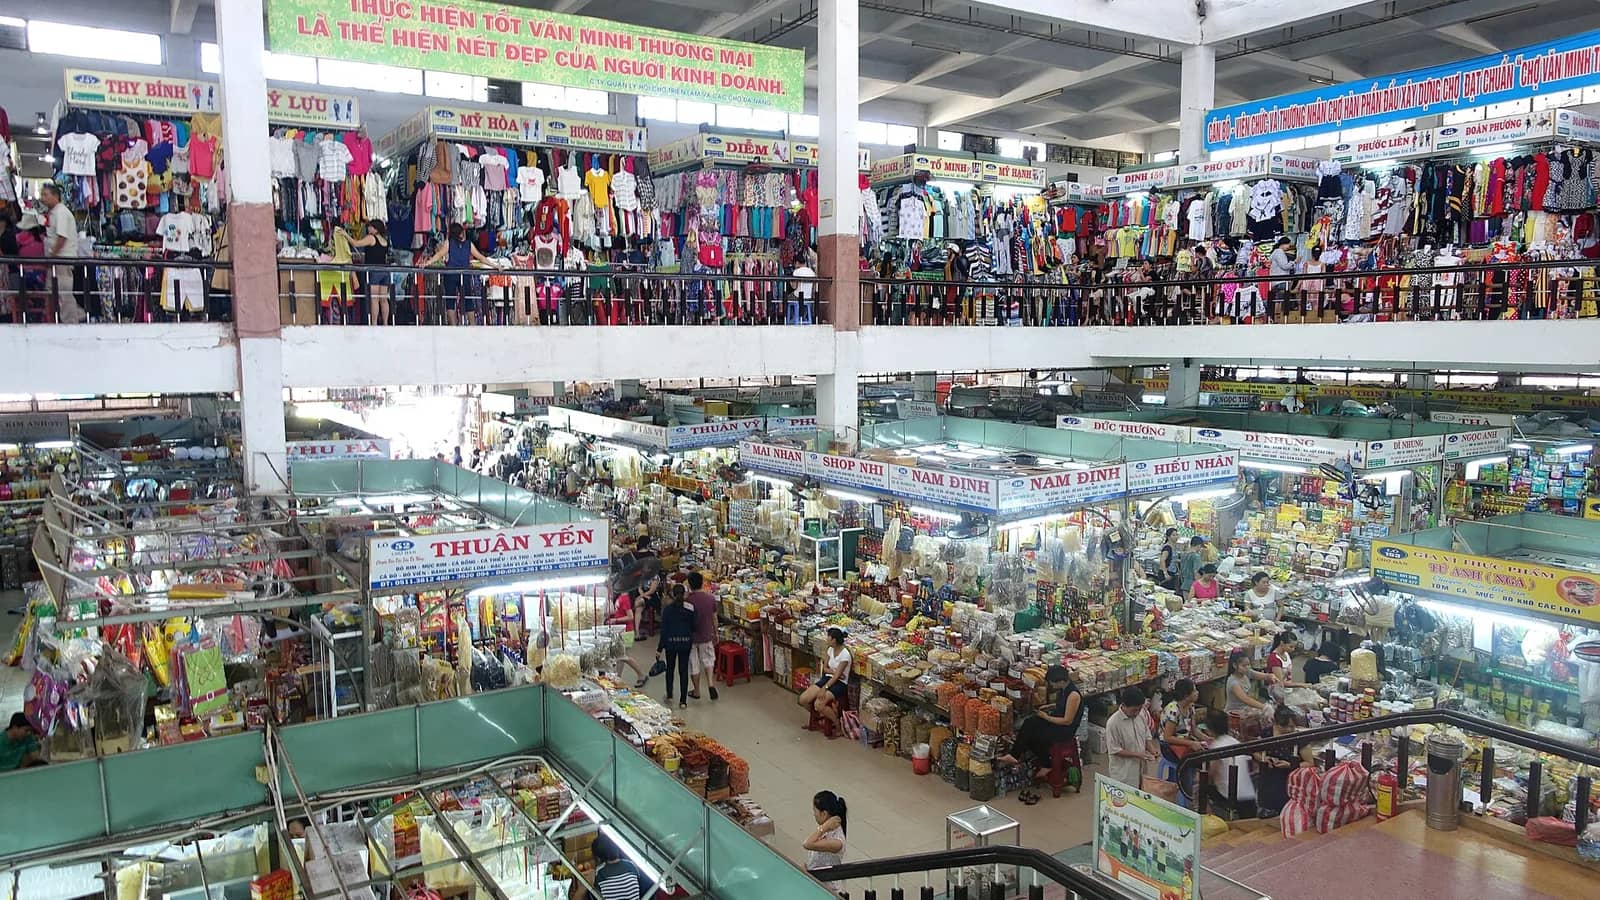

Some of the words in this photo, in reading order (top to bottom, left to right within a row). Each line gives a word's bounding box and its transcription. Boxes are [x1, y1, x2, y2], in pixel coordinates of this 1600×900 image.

[420, 7, 475, 30] HIỆN
[483, 8, 522, 36] TỐT
[530, 19, 573, 42] VĂN
[580, 28, 632, 50] MINH
[638, 37, 714, 62] THƯƠNG
[720, 49, 752, 70] MẠI
[297, 12, 330, 37] LÀ
[338, 16, 384, 44] THỂ
[393, 28, 448, 54] HIỆN
[457, 35, 497, 58] NÉT
[505, 44, 548, 66] ĐẸP
[555, 46, 597, 71] CỦA
[604, 56, 666, 80] NGƯỜI
[671, 66, 716, 87] KINH
[105, 80, 141, 95] THY
[1235, 112, 1249, 139] VIÊN
[1250, 108, 1269, 136] CHỨC
[1269, 105, 1279, 133] VÀ
[1279, 104, 1306, 131] THƯƠNG
[1307, 97, 1327, 127] NHÂN
[1328, 94, 1344, 126] CHỢ
[1344, 91, 1361, 120] HÀN
[1361, 82, 1382, 117] PHẤN
[1383, 79, 1399, 112] ĐẤU
[1400, 77, 1416, 109] XÂY
[1417, 77, 1440, 110] DỰNG
[1442, 72, 1461, 105] CHỢ
[1463, 71, 1481, 102] ĐẠT
[1482, 53, 1514, 94] CHUẨN
[1541, 49, 1562, 84] VĂN
[1563, 46, 1592, 79] MINH
[288, 95, 328, 114] LỰU
[605, 129, 624, 143] SEN
[1388, 136, 1410, 148] LIÊN
[944, 161, 968, 173] MINH
[752, 444, 770, 457] MAI
[823, 456, 856, 471] SHOP
[859, 462, 884, 476] NHI
[1195, 454, 1234, 470] NHÂN
[911, 469, 944, 487] NAM
[949, 475, 990, 495] ĐỊNH
[1030, 473, 1071, 491] NAM
[1076, 466, 1121, 486] ĐỊNH
[430, 532, 530, 557] THUẬN
[539, 524, 595, 549] YẾN
